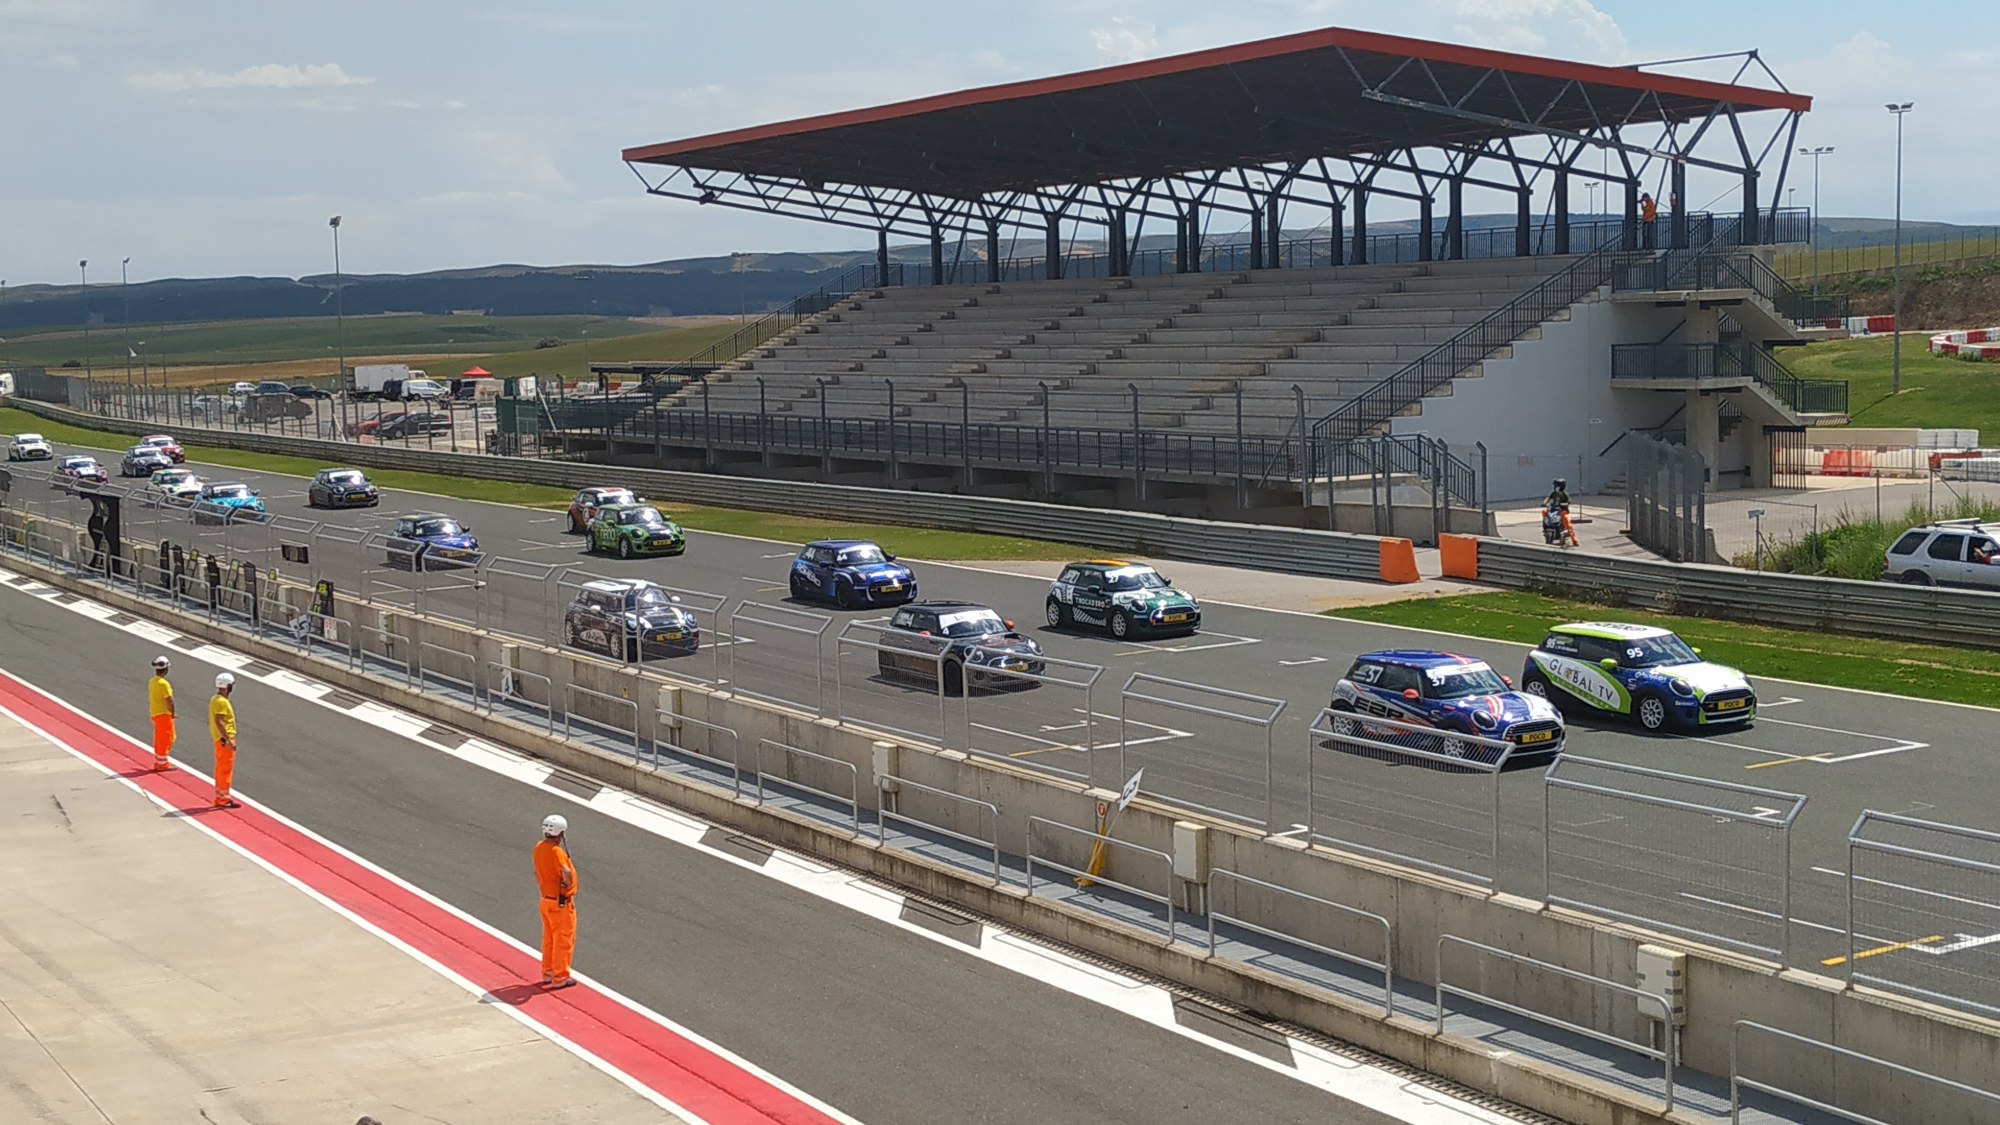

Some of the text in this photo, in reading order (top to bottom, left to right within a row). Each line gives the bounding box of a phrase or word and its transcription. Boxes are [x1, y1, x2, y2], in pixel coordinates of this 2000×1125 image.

[1546, 637, 1555, 649] 95
[1627, 647, 1644, 659] 95
[1365, 665, 1384, 683] 37
[1432, 675, 1445, 687] 37
[1598, 686, 1614, 701] TV
[1529, 733, 1546, 741] POCO
